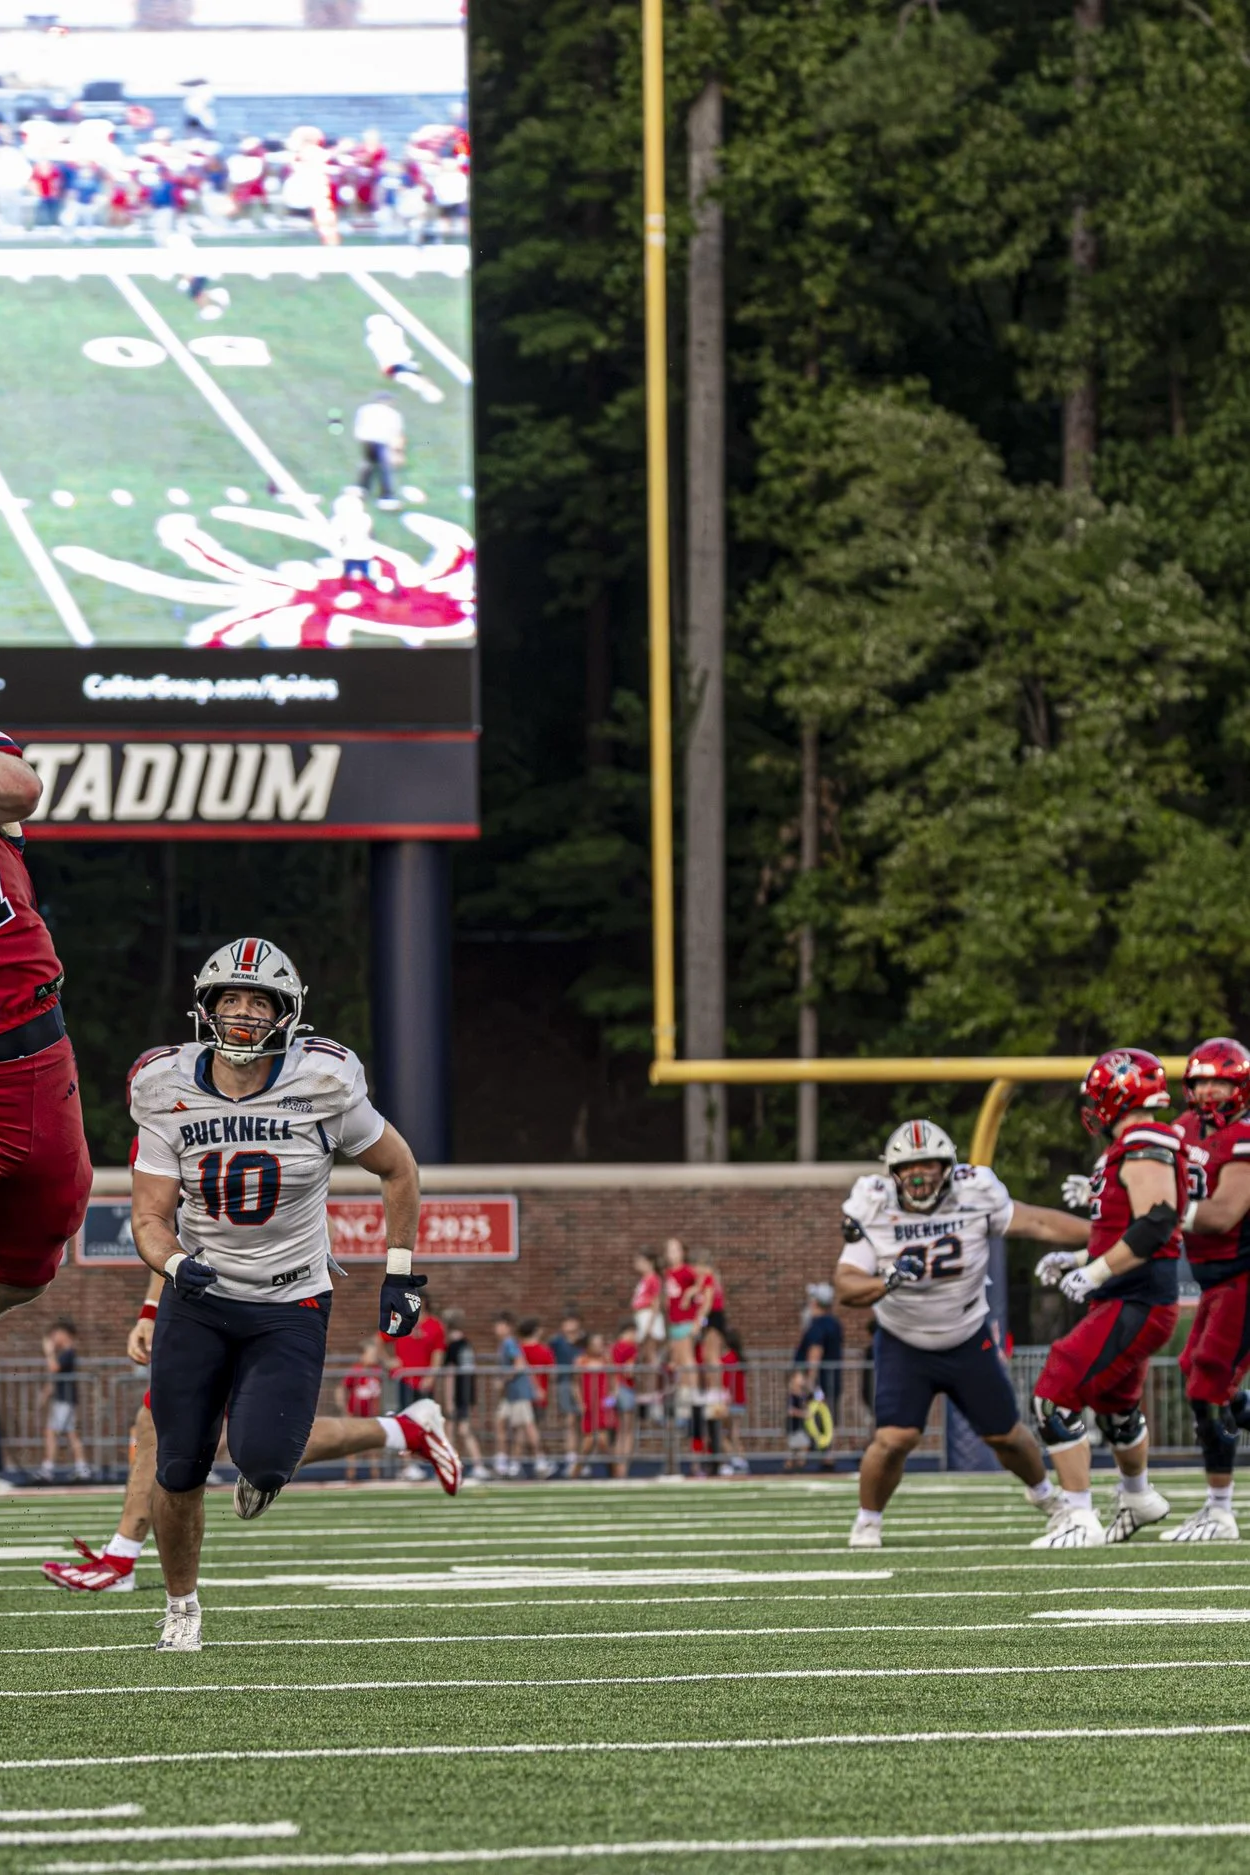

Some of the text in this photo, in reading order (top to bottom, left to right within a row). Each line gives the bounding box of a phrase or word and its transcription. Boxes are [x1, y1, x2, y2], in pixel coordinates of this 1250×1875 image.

[22, 742, 341, 821] TADIUM
[231, 972, 258, 981] BUCKNELL
[179, 1116, 293, 1146] BUCKNELL
[197, 1150, 282, 1226] 10
[425, 1214, 491, 1242] 2025
